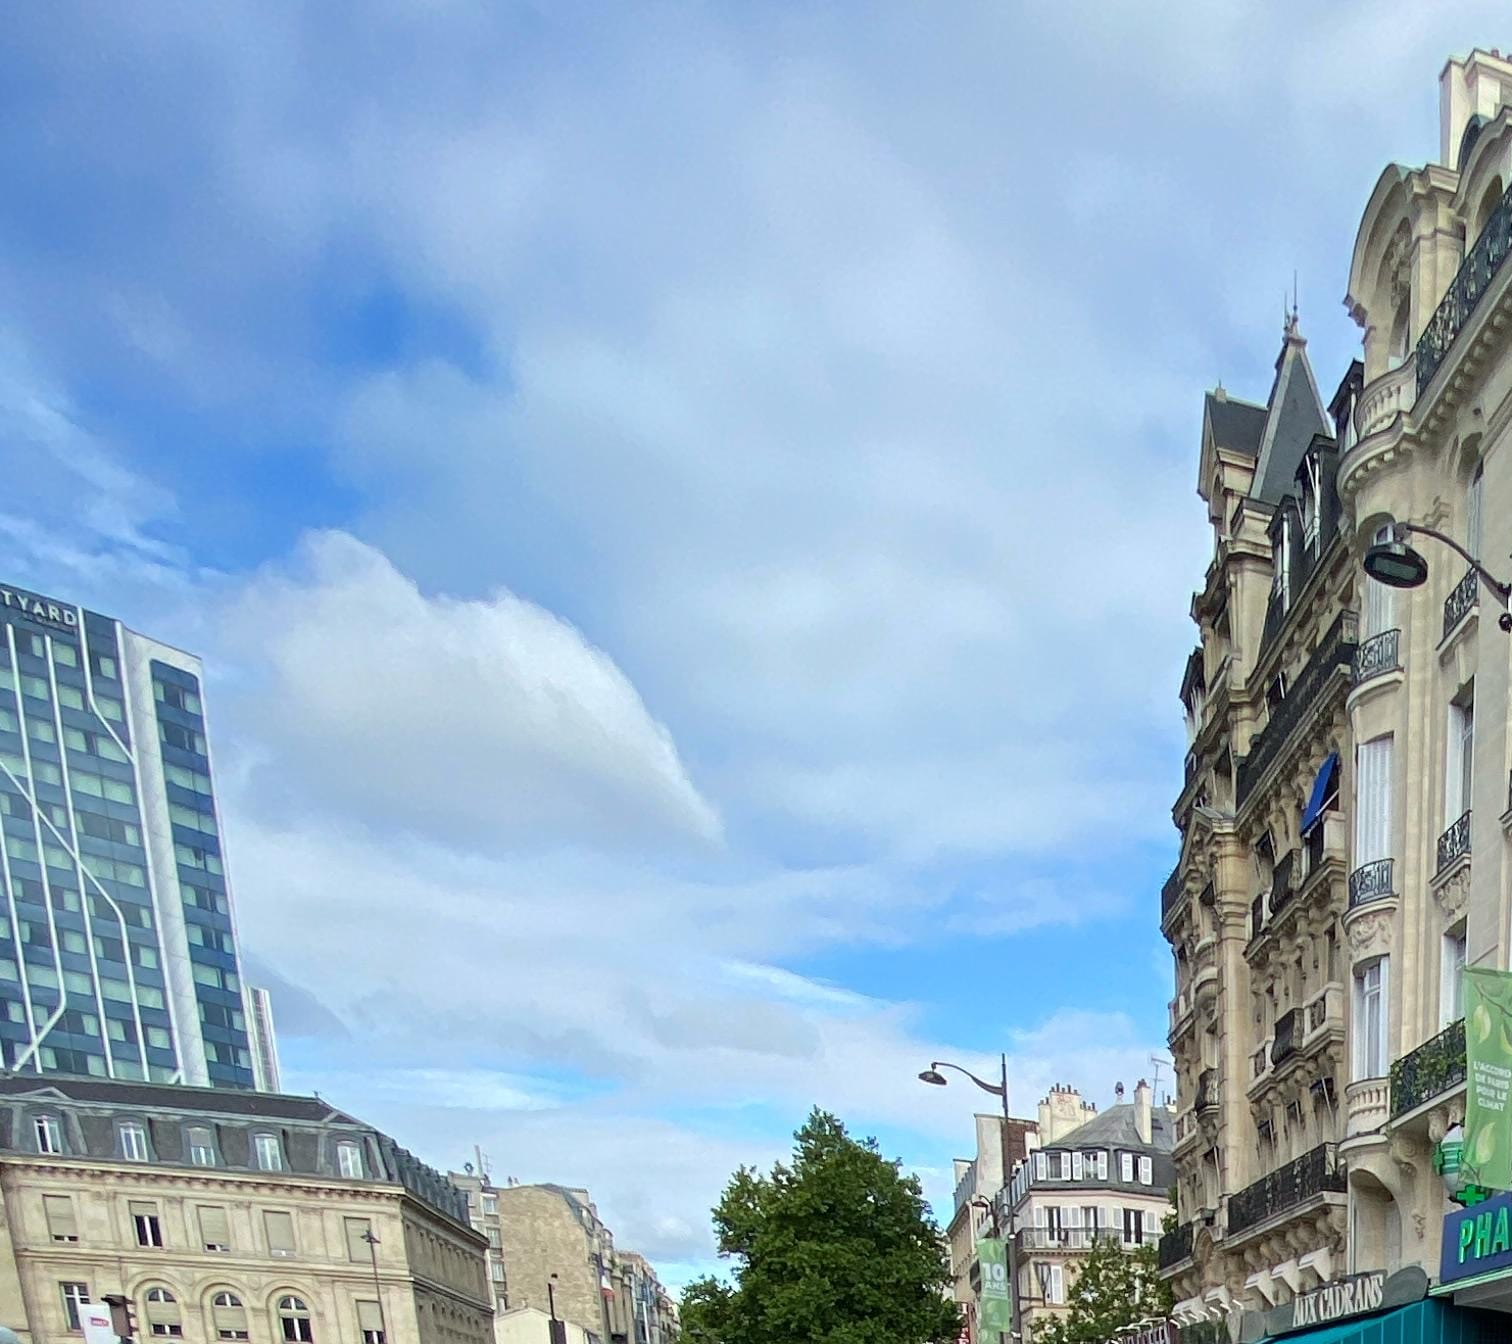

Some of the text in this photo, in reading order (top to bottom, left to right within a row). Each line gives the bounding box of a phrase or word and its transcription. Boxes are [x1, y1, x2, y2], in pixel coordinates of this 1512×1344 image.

[0, 589, 78, 626] TYARD
[982, 1262, 1006, 1281] 10
[983, 1282, 1007, 1291] ANS
[1292, 1273, 1384, 1328] AUX CADRANS
